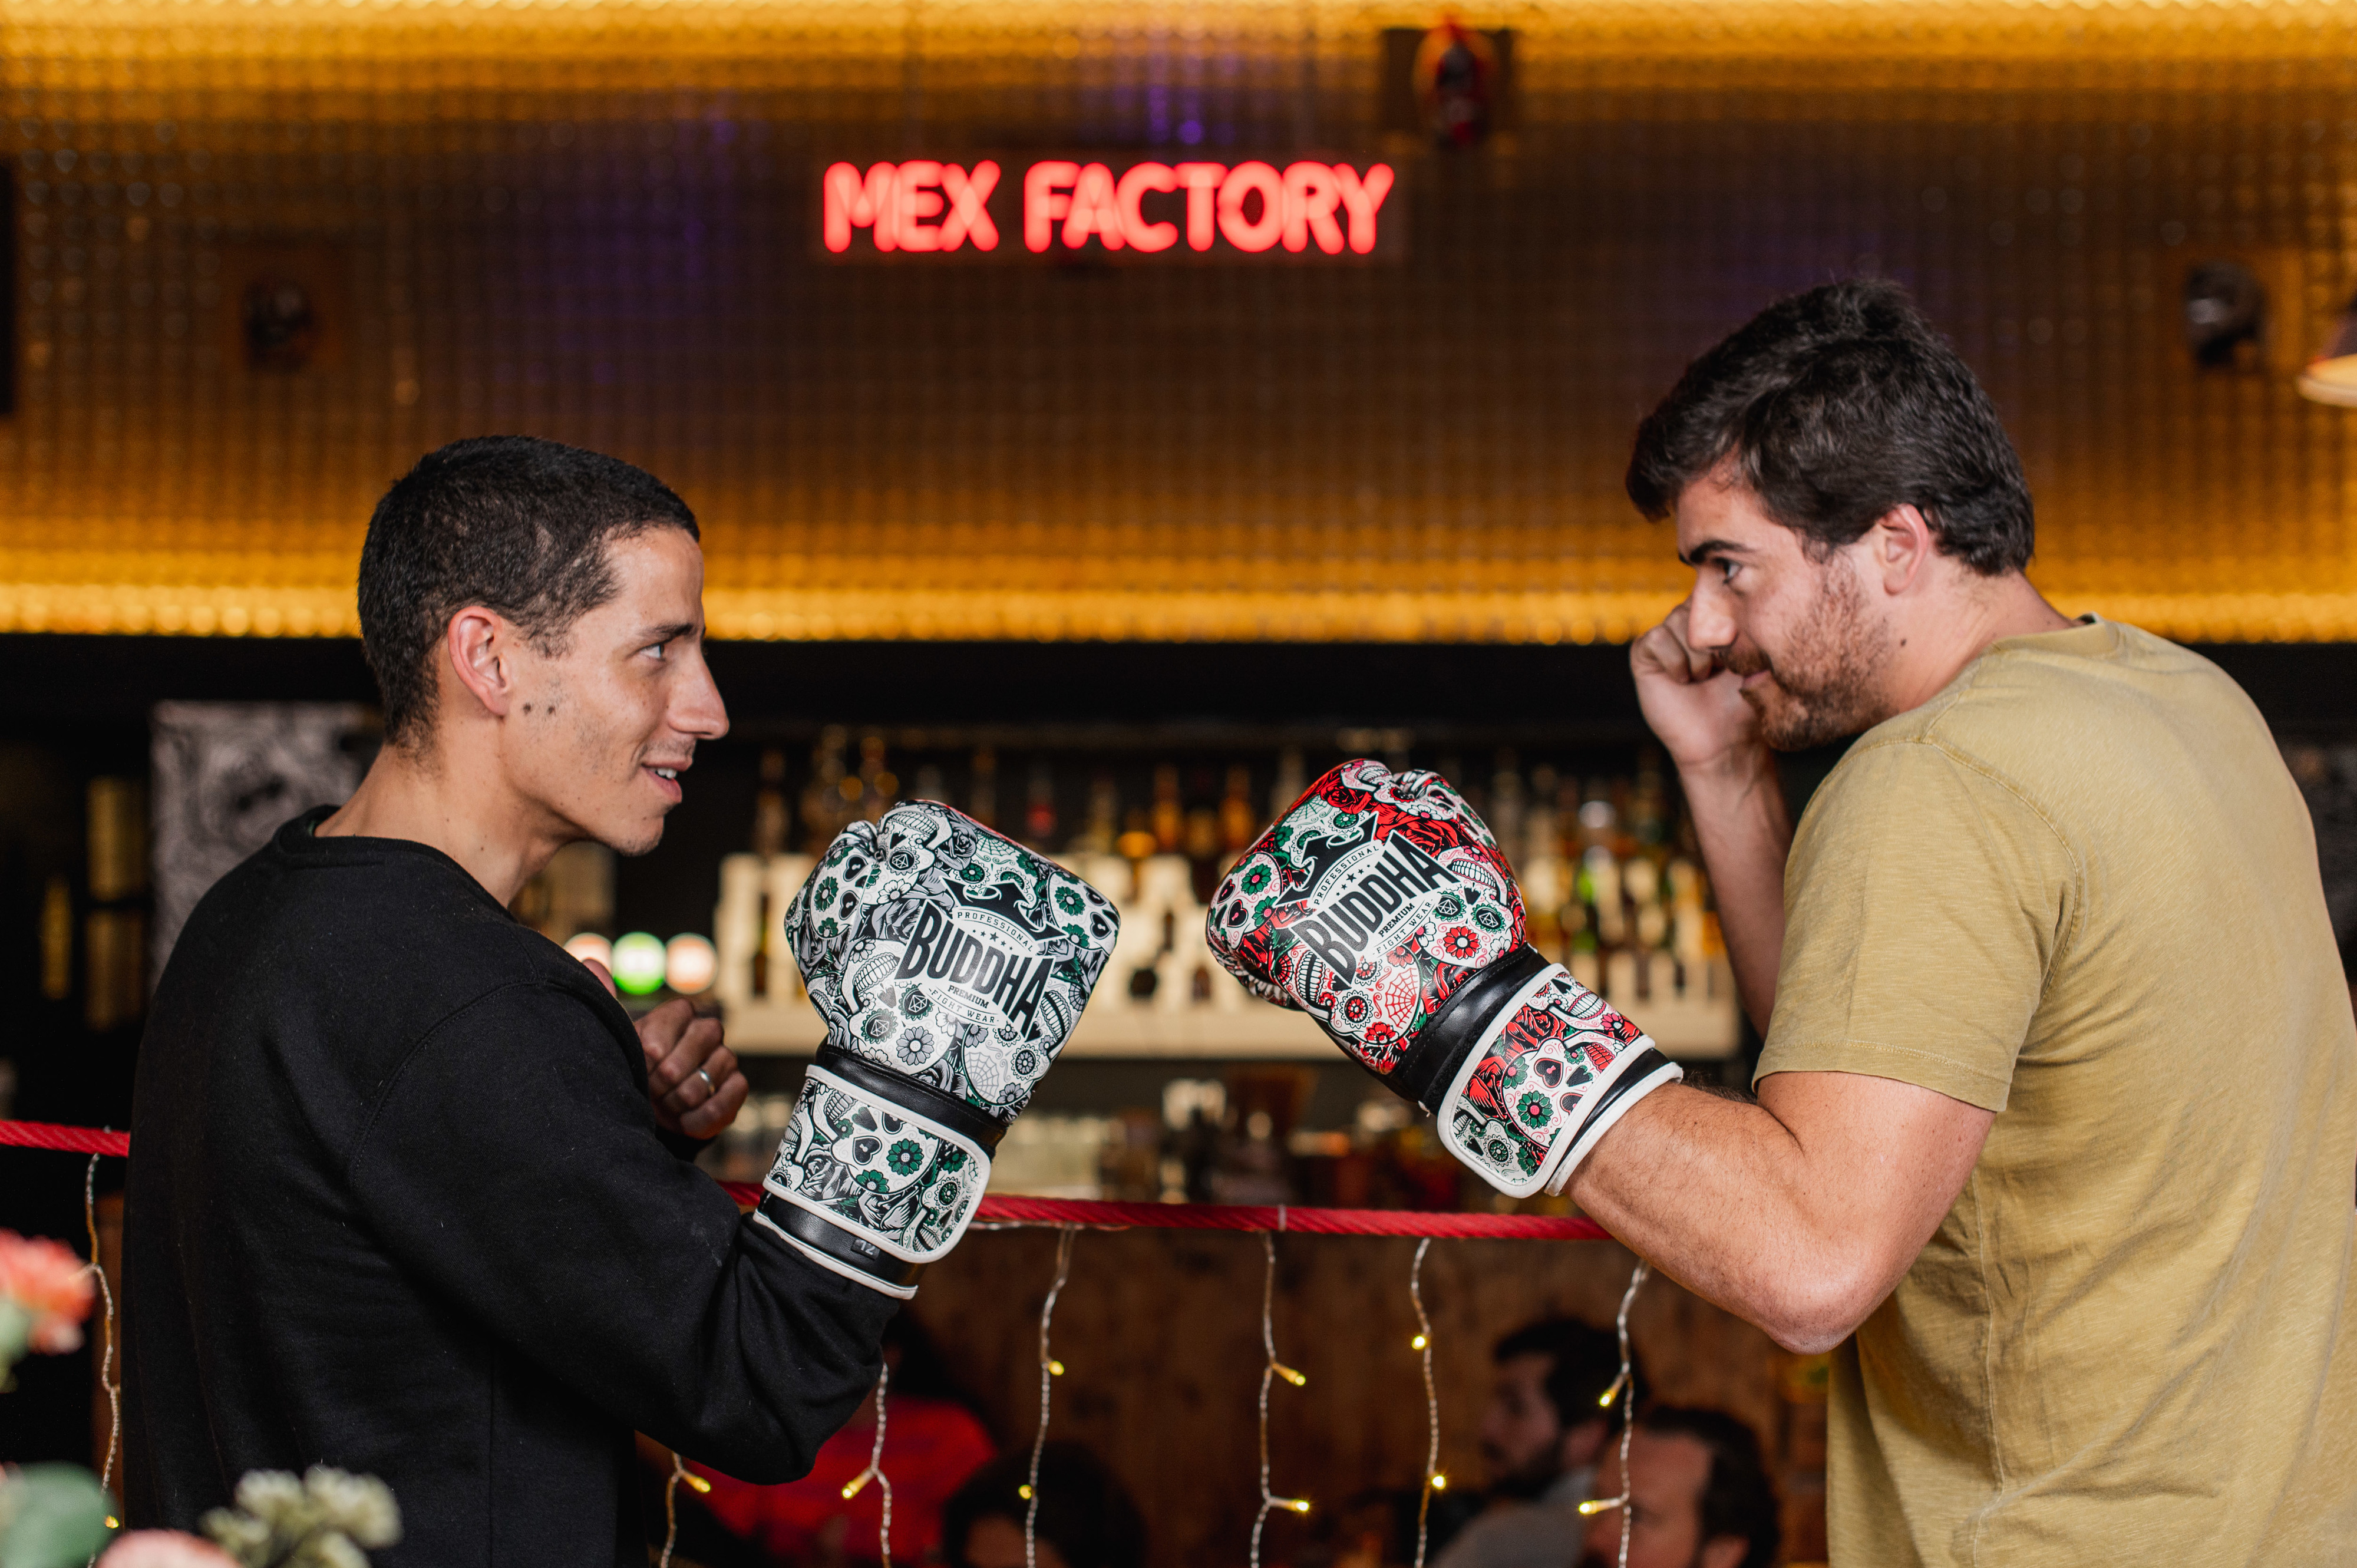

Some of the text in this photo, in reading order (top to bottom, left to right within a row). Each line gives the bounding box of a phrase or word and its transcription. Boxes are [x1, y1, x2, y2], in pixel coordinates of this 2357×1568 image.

[824, 160, 1395, 255] MEX FACTORY
[1313, 845, 1379, 906] PROFESSIONAL
[958, 912, 1034, 952] PROFESSIONAL
[1291, 831, 1461, 985] BUDDHA
[1378, 902, 1415, 938] PREMIUM
[894, 902, 1054, 1039] BUDDHA
[947, 985, 990, 1009] PREMIUM
[860, 1239, 876, 1256] 12
